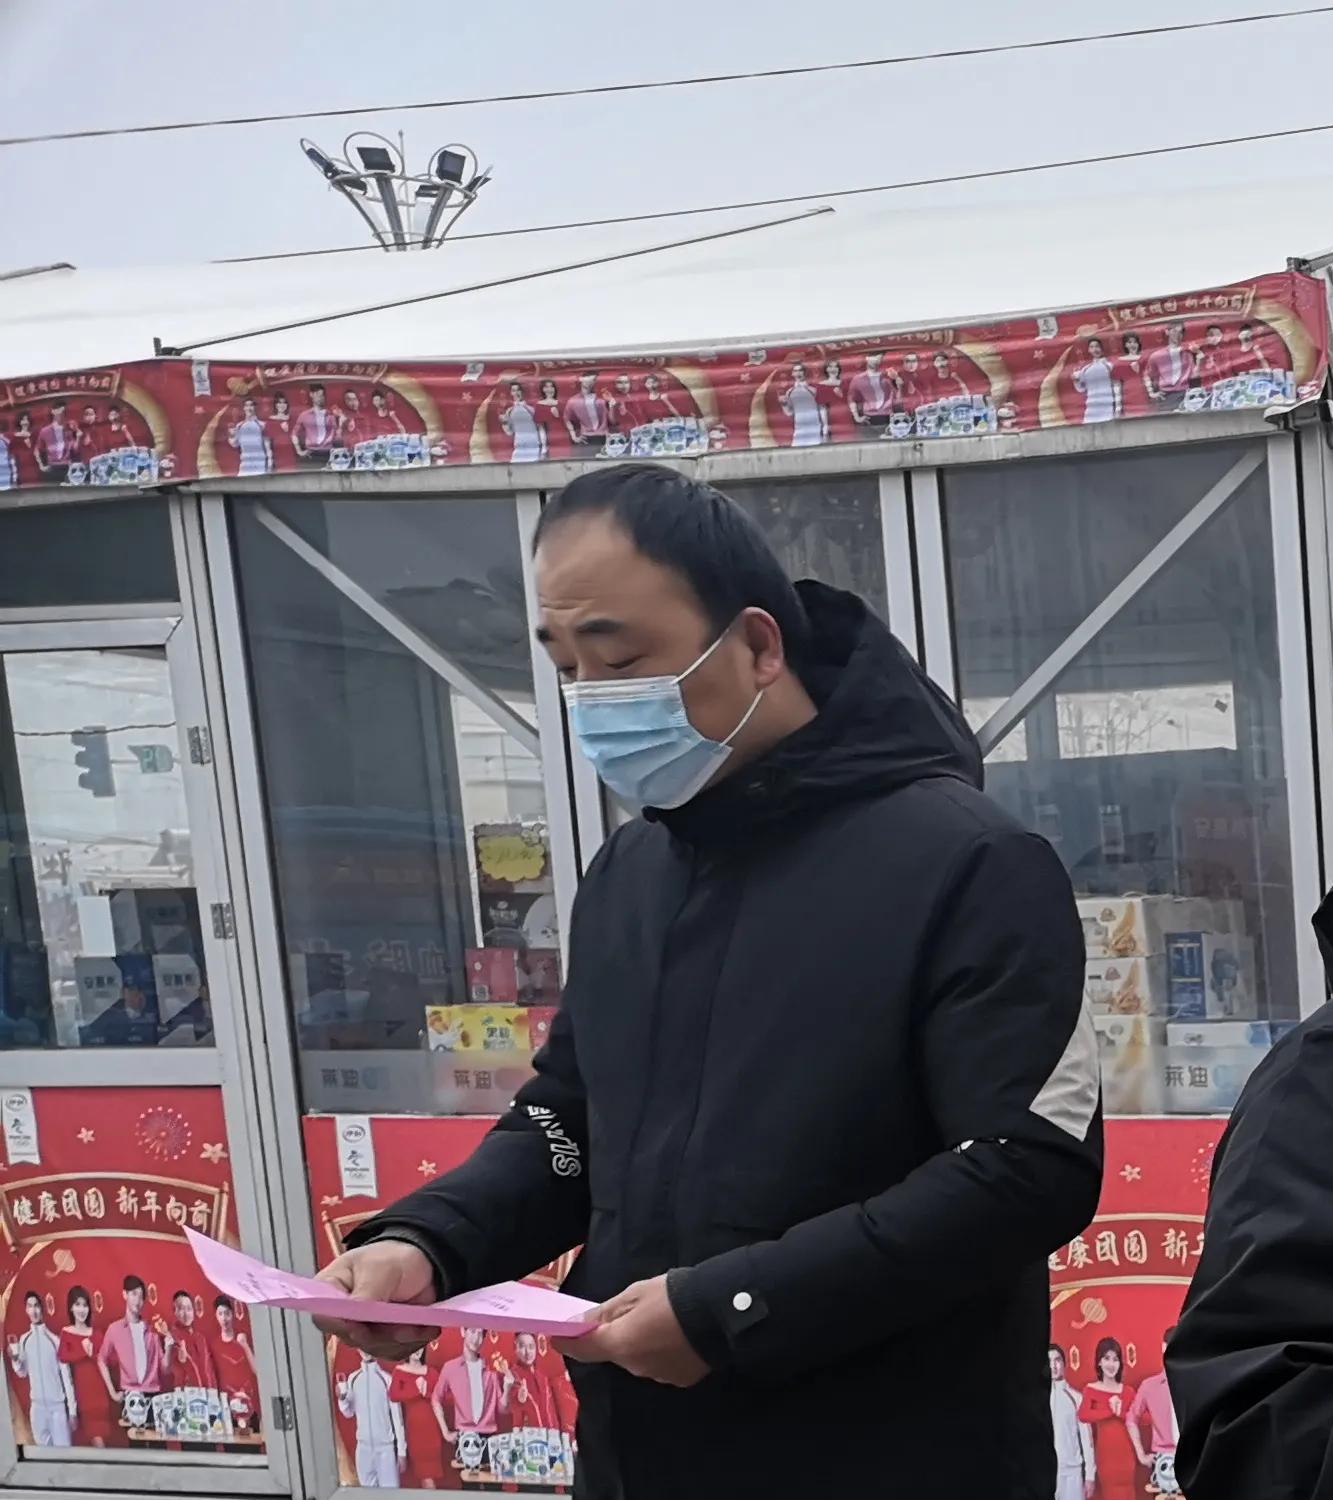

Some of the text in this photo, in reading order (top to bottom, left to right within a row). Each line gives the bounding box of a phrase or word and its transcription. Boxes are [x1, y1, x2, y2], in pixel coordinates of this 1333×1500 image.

[13, 1185, 214, 1233] 健康团圆 新年向前
